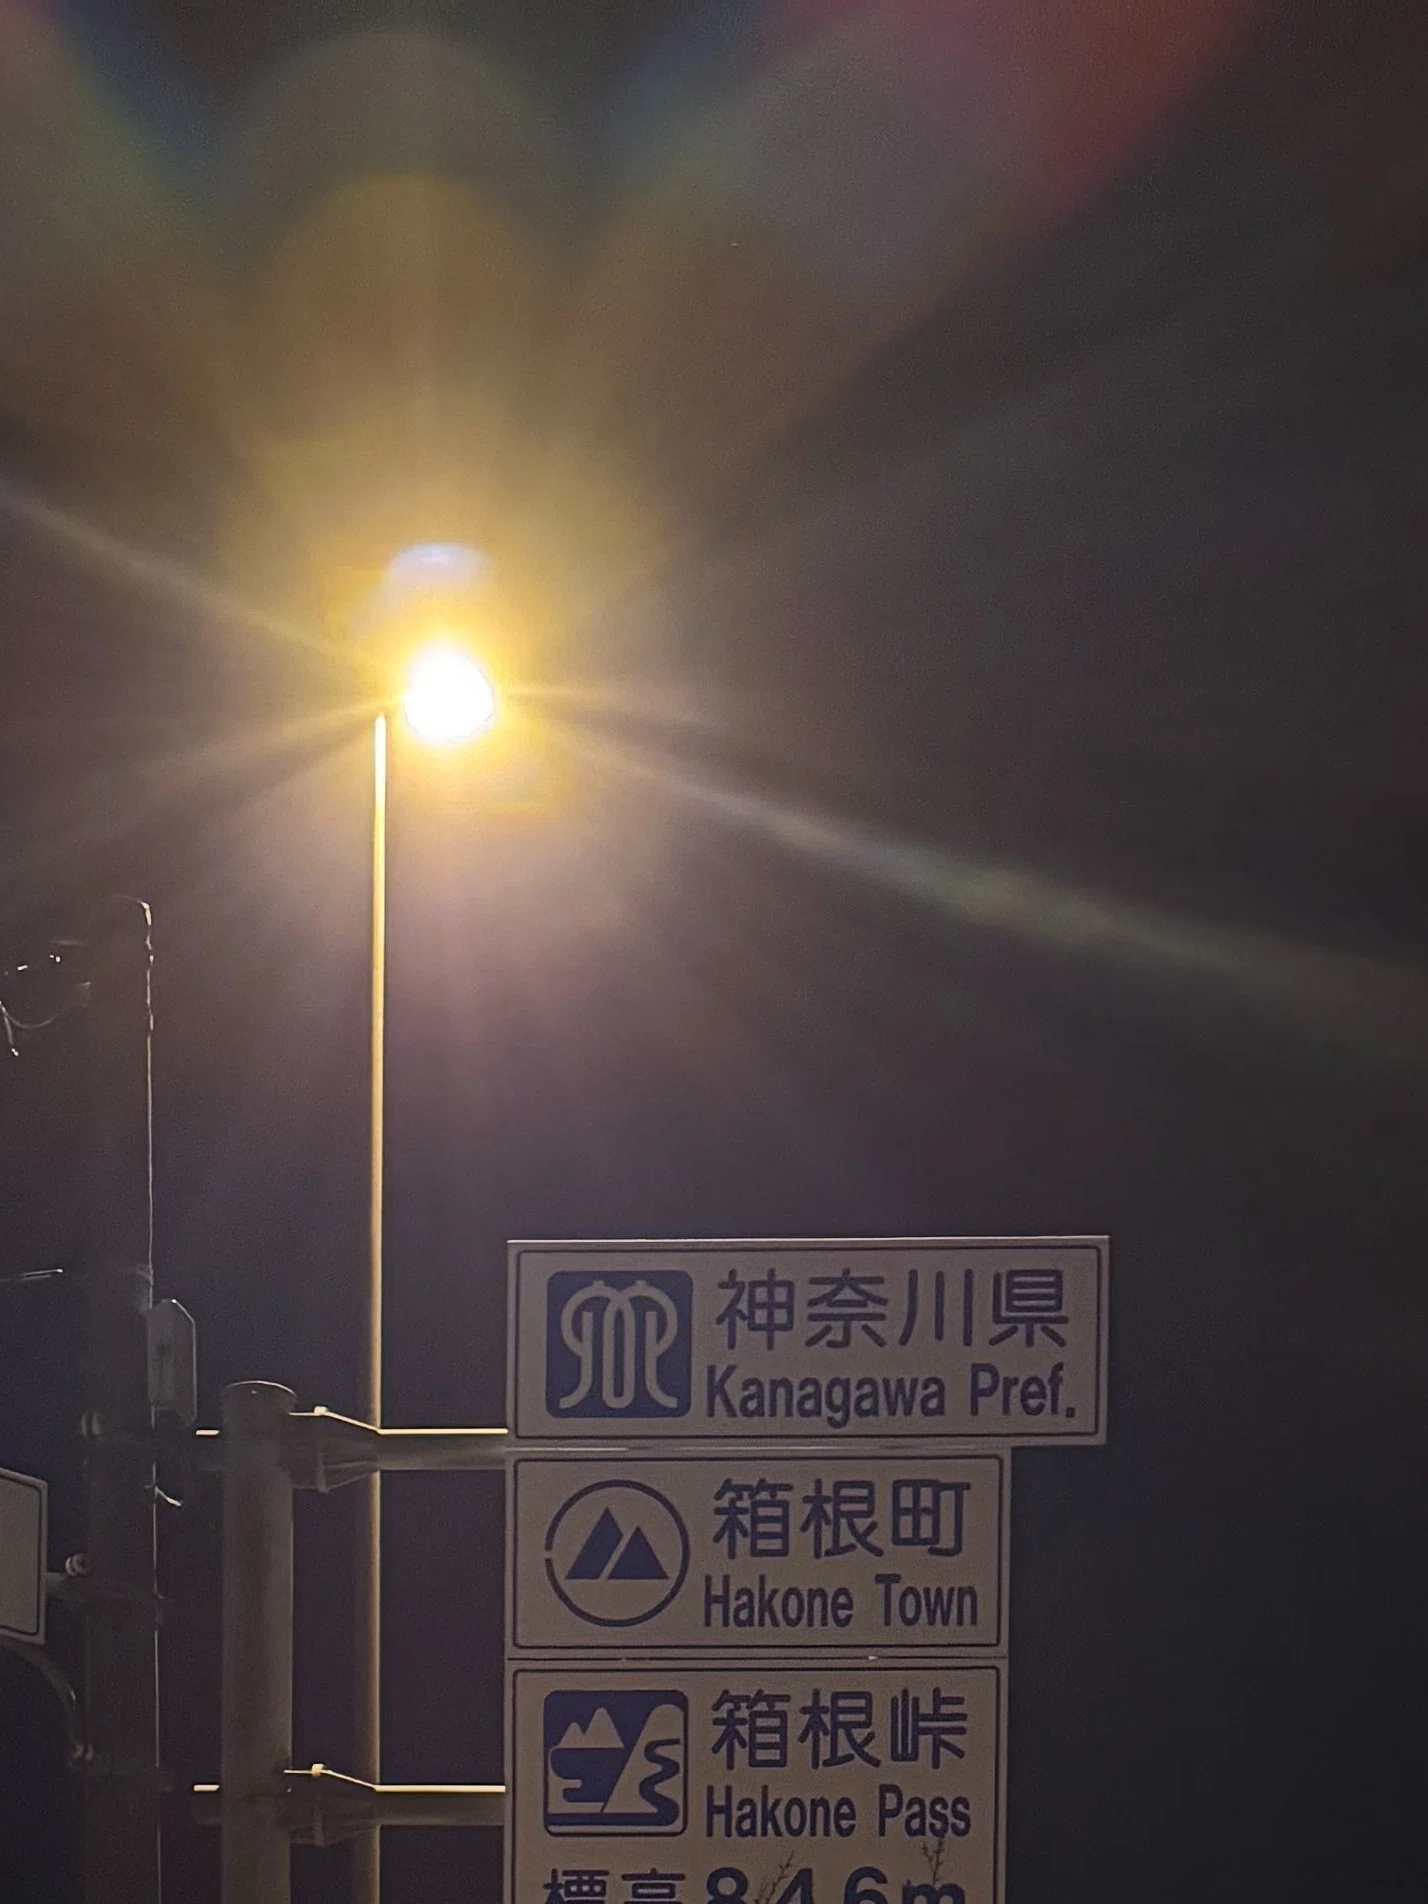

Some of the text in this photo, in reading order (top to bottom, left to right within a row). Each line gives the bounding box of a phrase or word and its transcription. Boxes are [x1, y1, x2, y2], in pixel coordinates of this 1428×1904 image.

[713, 1266, 1070, 1351] 神奈川県
[706, 1362, 1077, 1427] Kanagawa Pref.
[712, 1477, 972, 1560] 箱根町
[702, 1574, 978, 1629] Hakone Town
[710, 1688, 969, 1771] 箱根峠
[705, 1785, 972, 1839] Hakone Pass
